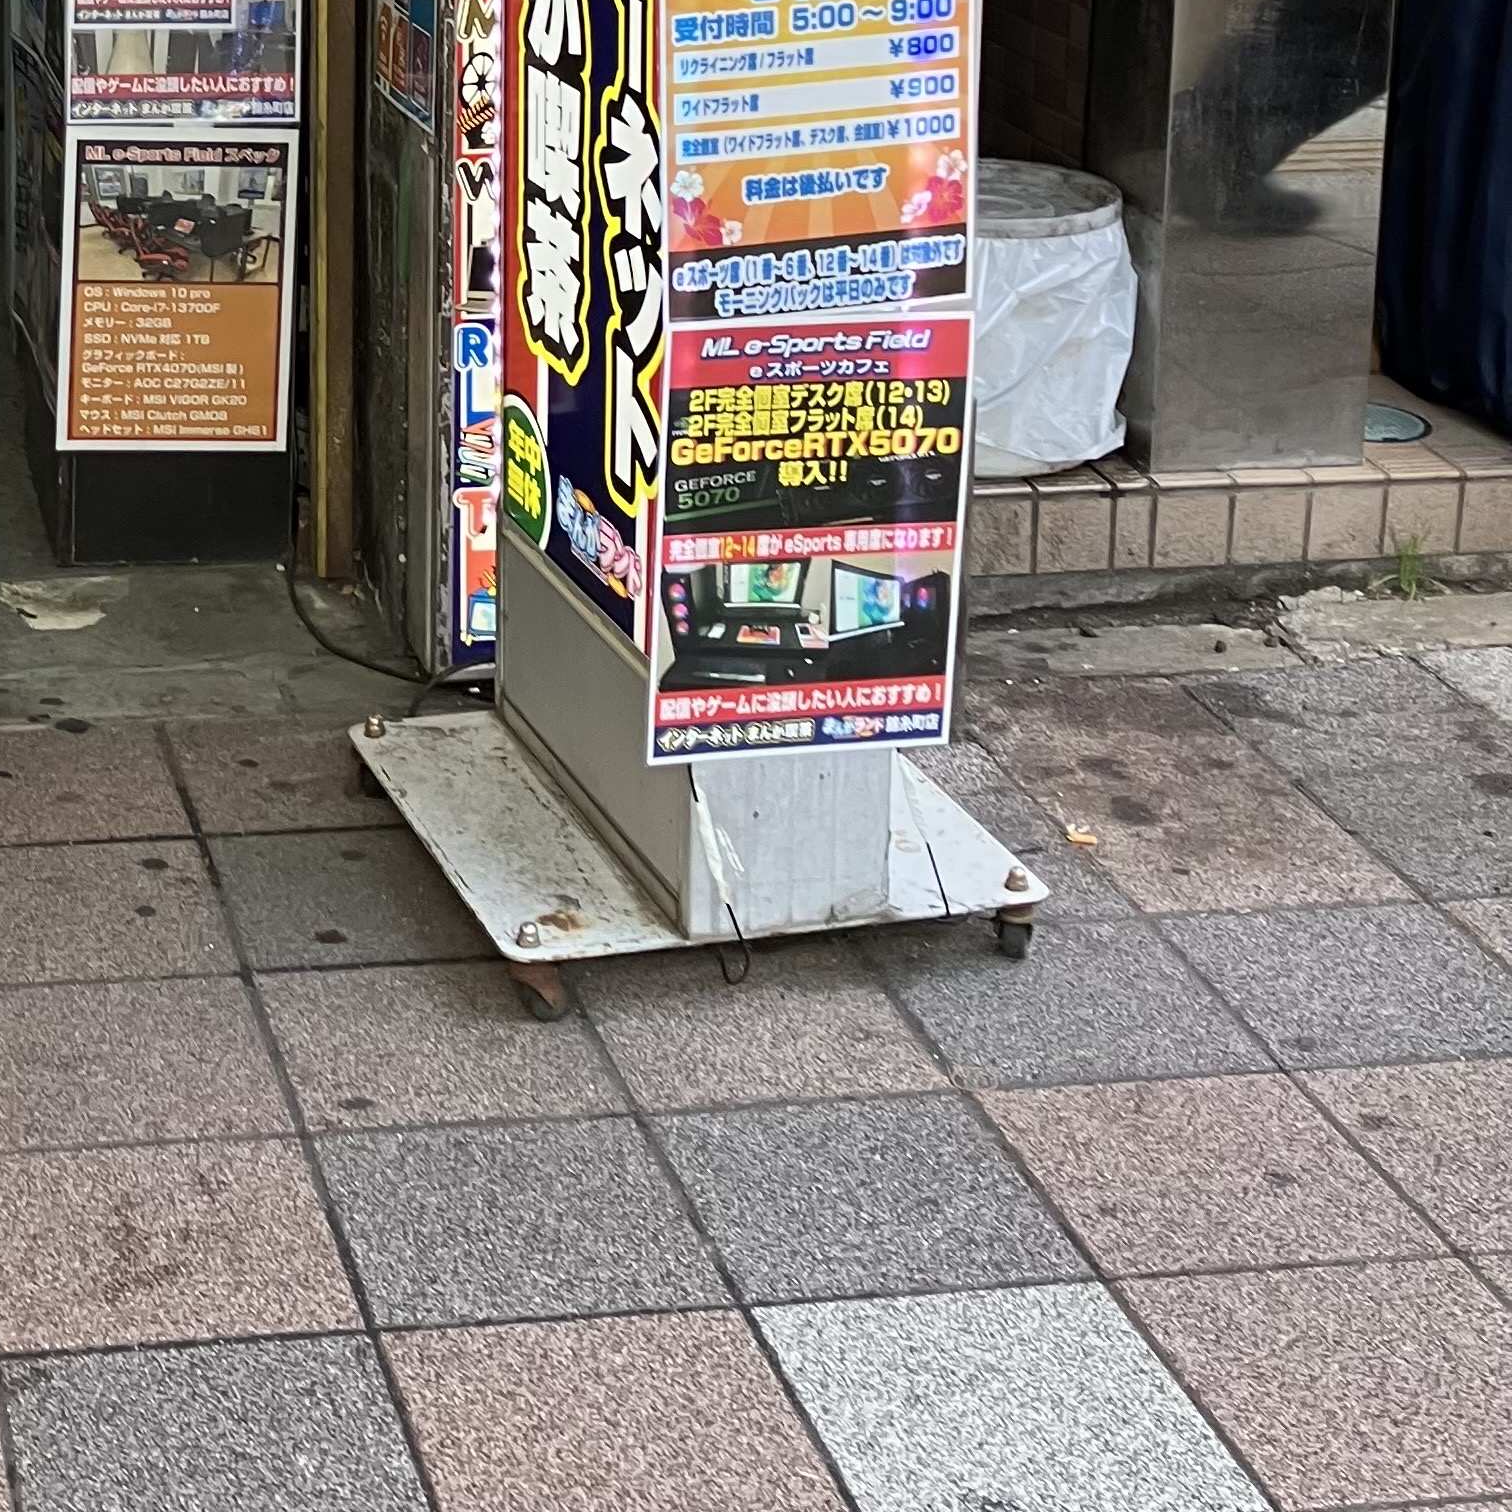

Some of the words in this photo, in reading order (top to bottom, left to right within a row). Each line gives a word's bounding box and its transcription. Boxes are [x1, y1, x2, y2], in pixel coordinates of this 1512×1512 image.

[672, 11, 777, 43] 受付時間
[887, 32, 955, 58] ¥800
[72, 101, 138, 117] インターネット
[681, 93, 760, 118] ワイドフラット席
[889, 73, 956, 100] ¥900
[887, 113, 957, 139] ¥1000
[84, 145, 111, 161] ML
[183, 147, 223, 163] Field
[224, 146, 281, 164] スペック
[744, 166, 888, 202] 料金は後払いです
[717, 272, 913, 315] モーニングパックは平日のみです
[700, 336, 740, 359] ML
[743, 332, 867, 359] e-Sports
[865, 328, 932, 352] Field
[81, 362, 134, 373] GeForce
[671, 426, 961, 467] GeForceRTX5070
[673, 470, 758, 493] GEFORCE
[677, 487, 742, 509] 5070
[659, 682, 942, 723] 配信やゲームに没頭したい人におすすめ！
[657, 724, 744, 753] インターネット
[745, 718, 816, 744] まんが喫茶
